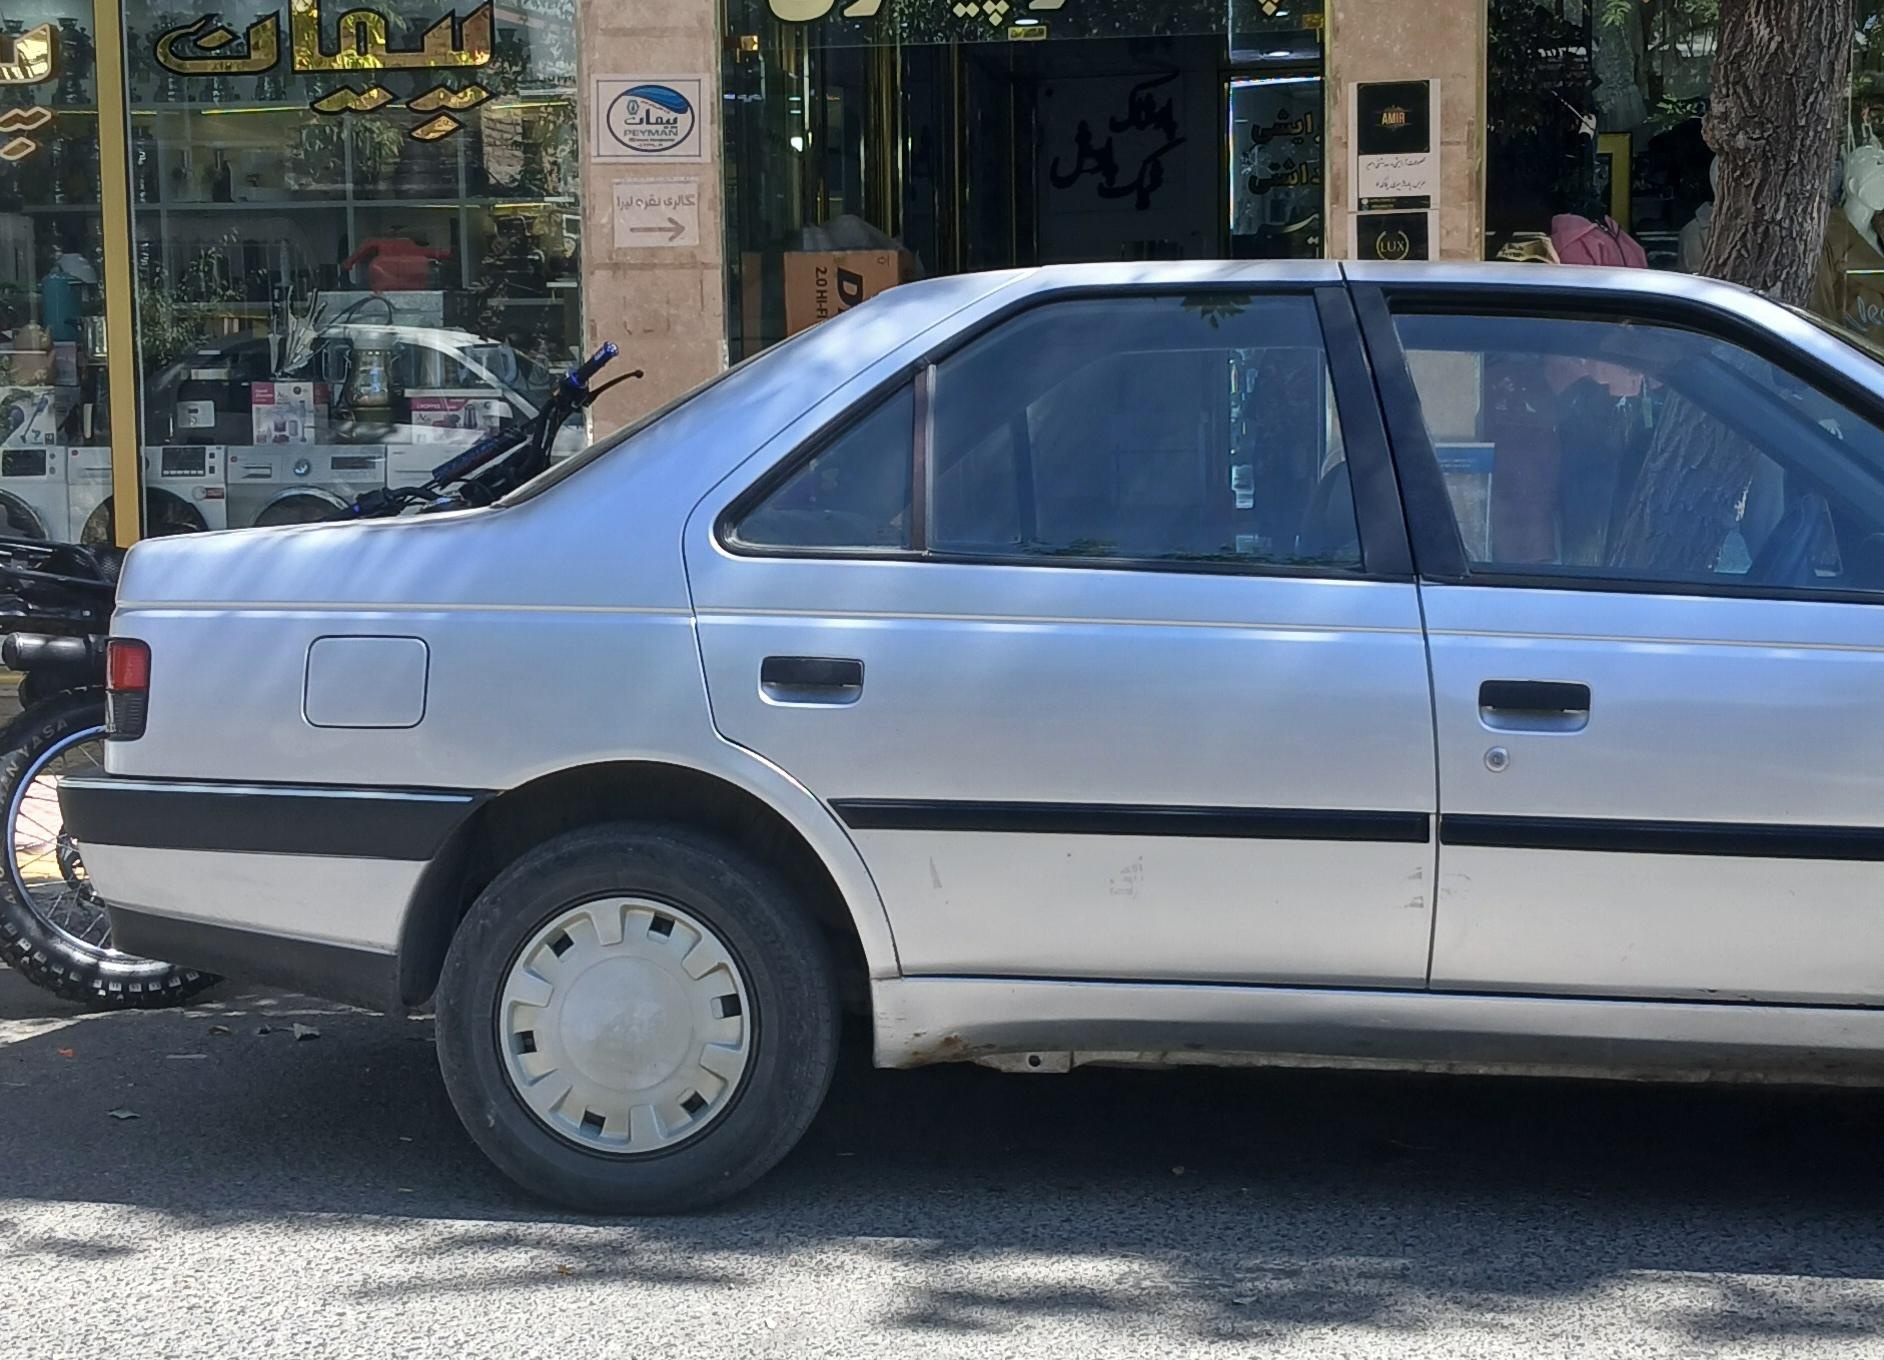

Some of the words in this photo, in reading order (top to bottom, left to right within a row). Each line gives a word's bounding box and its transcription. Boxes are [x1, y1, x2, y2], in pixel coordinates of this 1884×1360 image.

[624, 108, 678, 128] پیمان
[1381, 111, 1406, 126] AMIR
[636, 194, 661, 210] نقره
[664, 194, 696, 210] گالری
[1380, 240, 1405, 252] LUX
